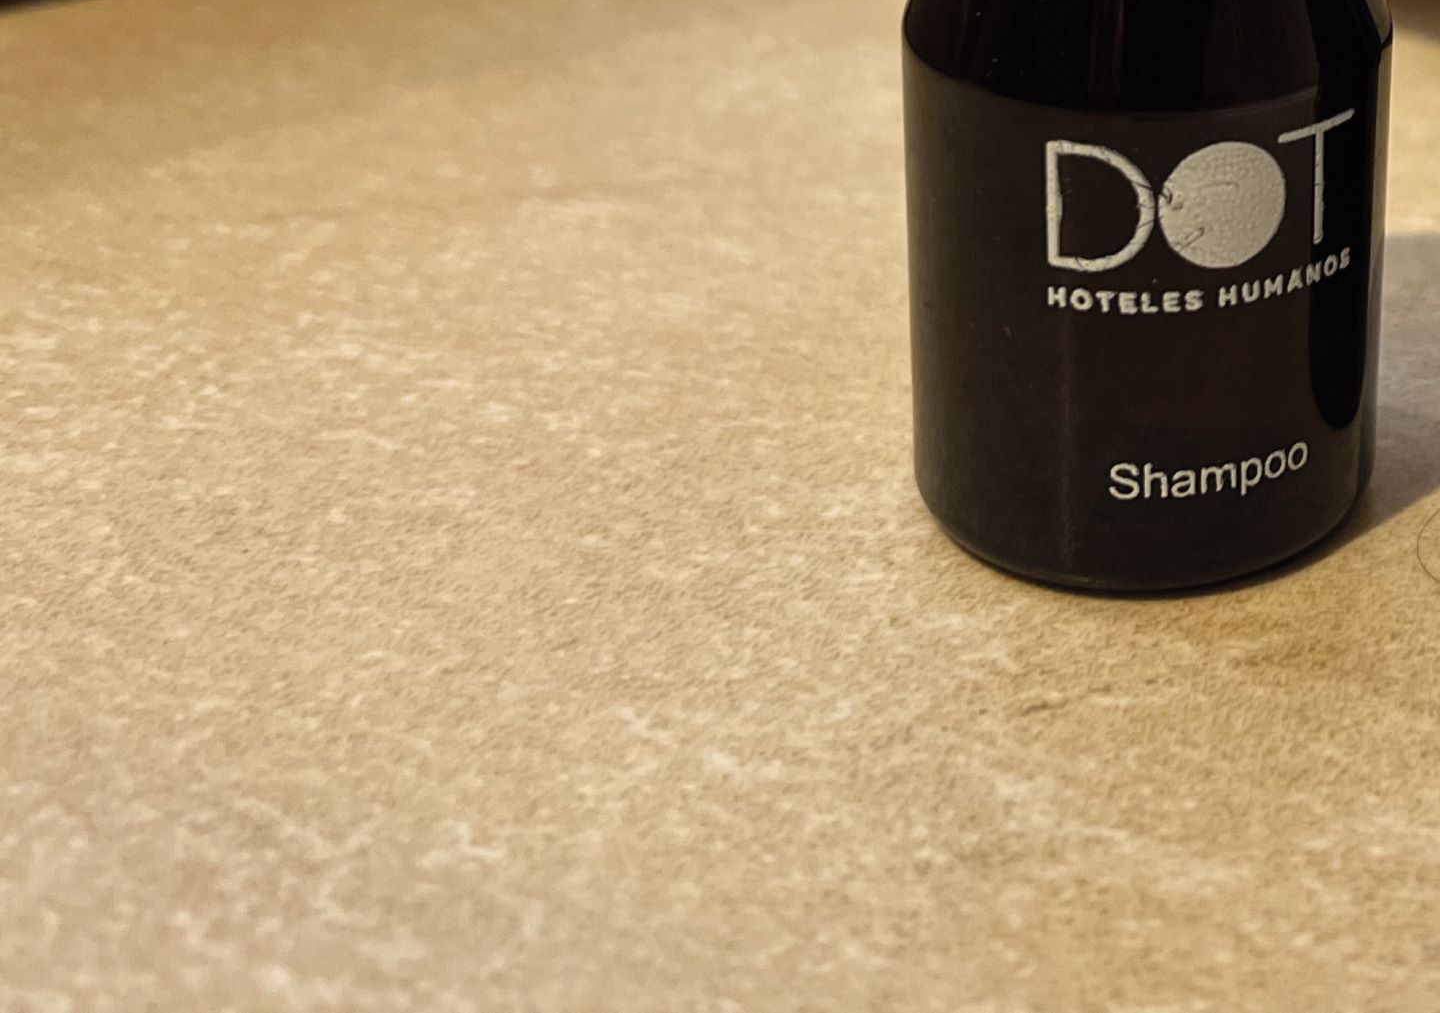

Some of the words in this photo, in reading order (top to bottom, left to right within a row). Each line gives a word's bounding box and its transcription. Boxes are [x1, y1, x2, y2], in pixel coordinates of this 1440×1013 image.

[1045, 107, 1355, 273] DOT
[1047, 286, 1204, 314] HOTELES
[1217, 246, 1352, 308] HUMANOS
[1108, 441, 1309, 500] Shampoo
